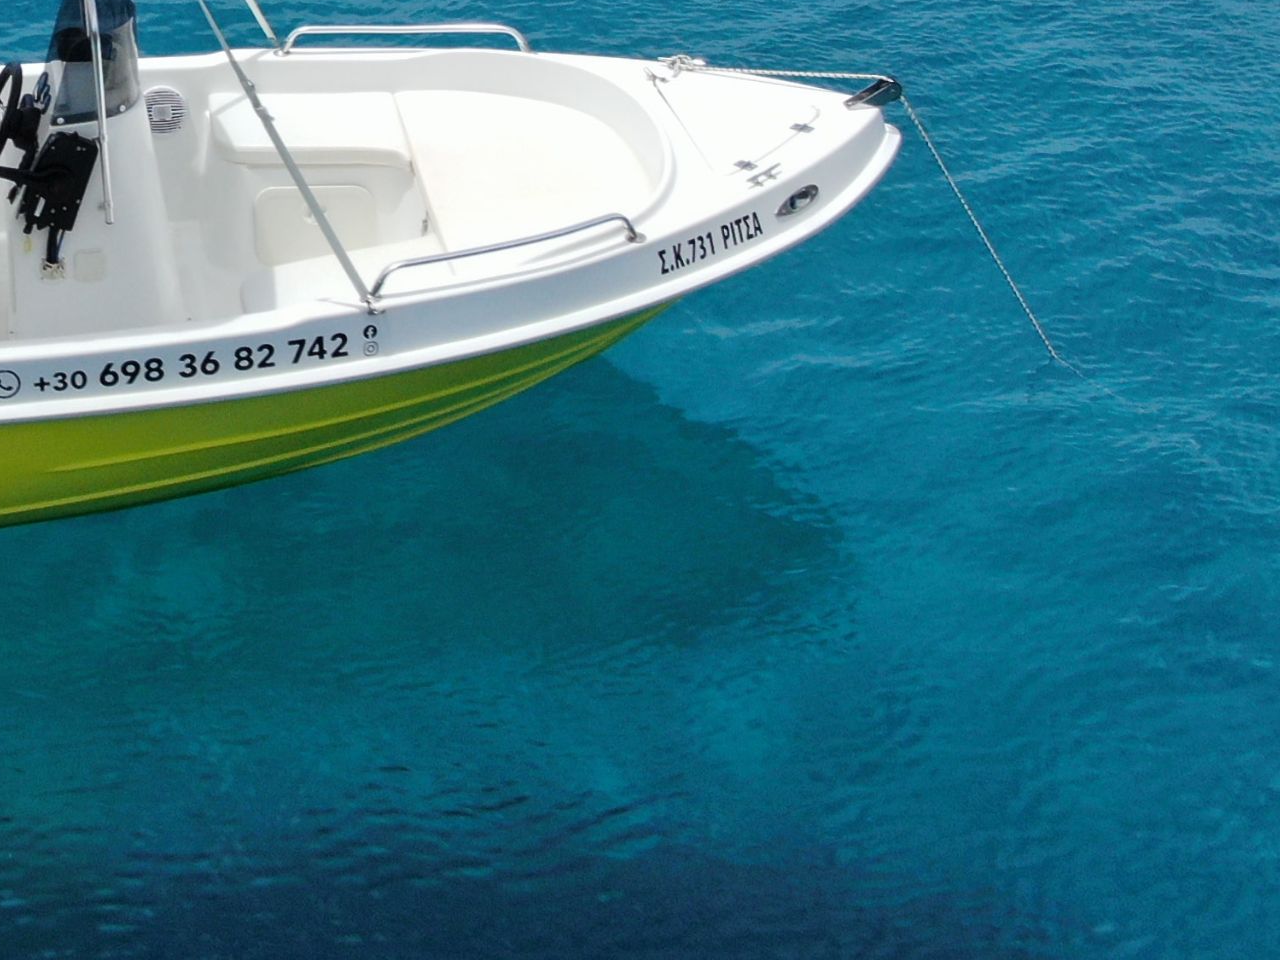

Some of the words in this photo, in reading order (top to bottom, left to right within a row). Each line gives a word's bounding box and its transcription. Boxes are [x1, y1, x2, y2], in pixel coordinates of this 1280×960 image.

[657, 231, 715, 275] Σ.Κ.731
[720, 211, 763, 249] ΡΙΤΣΑ
[33, 370, 88, 392] +30
[99, 357, 165, 387] 698
[178, 352, 220, 378] 36
[233, 343, 276, 371] 82
[287, 332, 349, 364] 742
